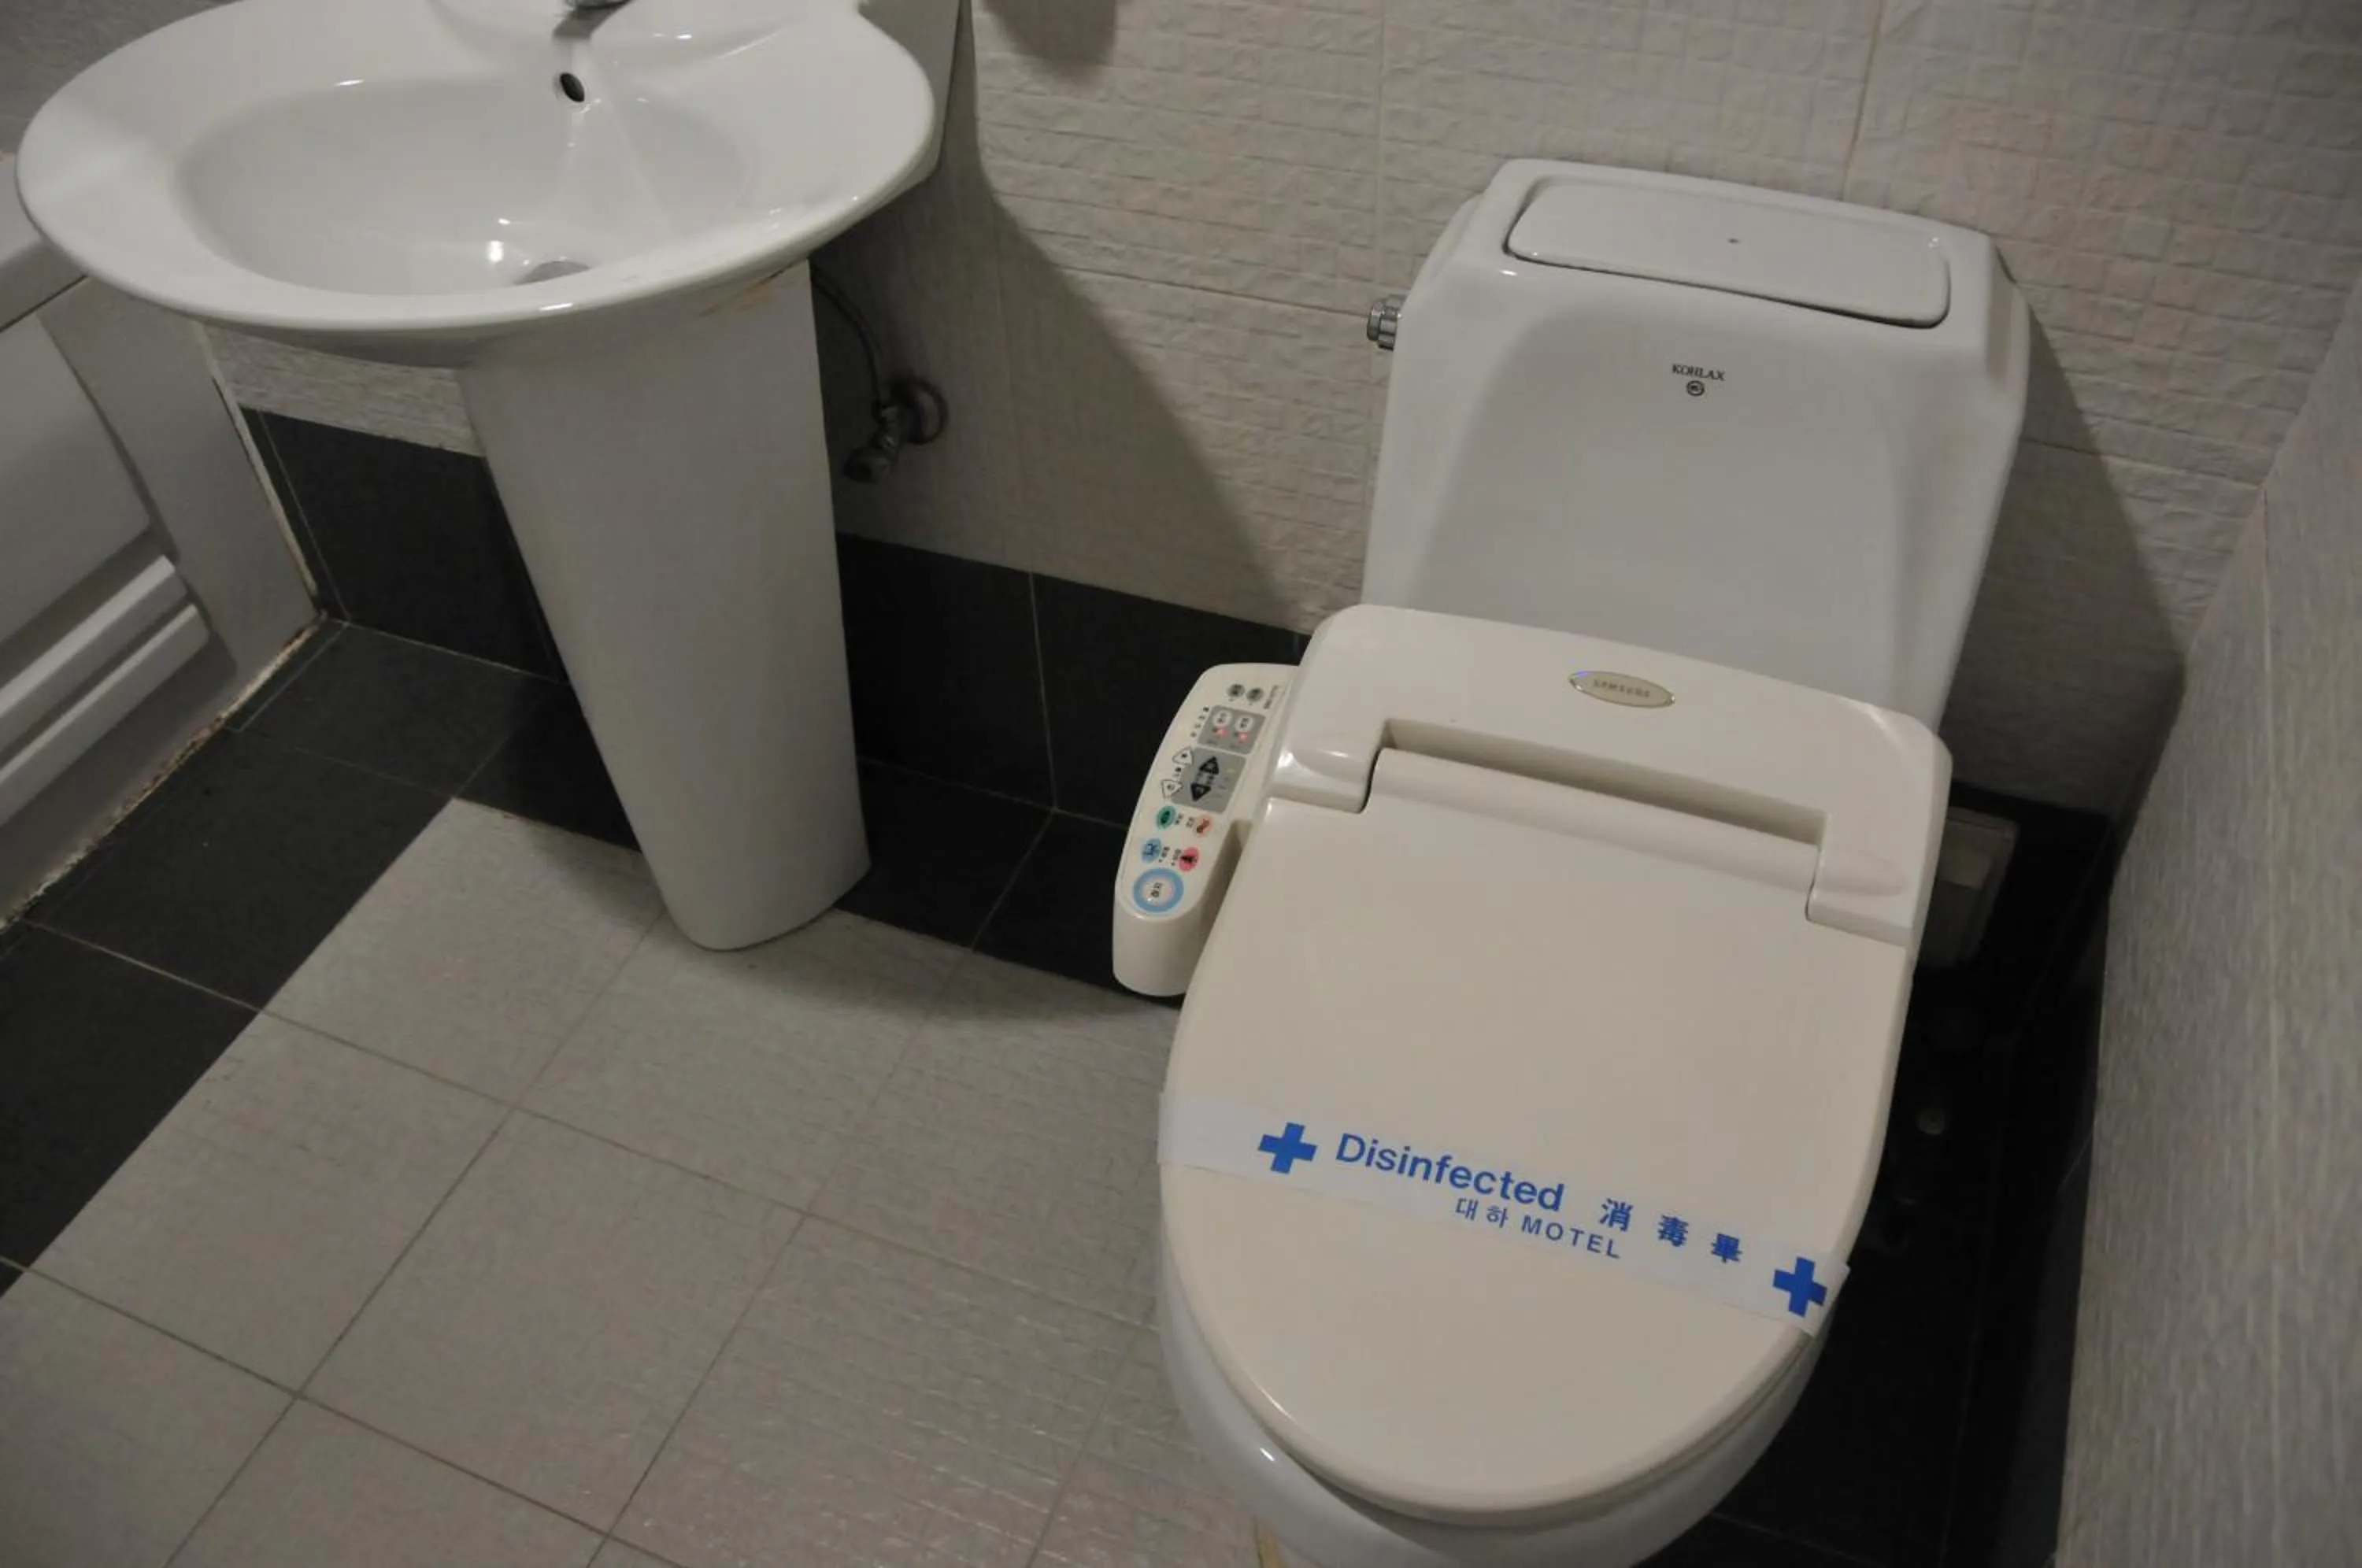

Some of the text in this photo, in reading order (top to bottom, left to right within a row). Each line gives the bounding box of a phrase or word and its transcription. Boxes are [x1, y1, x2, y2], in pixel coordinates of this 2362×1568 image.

[1593, 679, 1650, 698] SAMSUNG
[1335, 1133, 1564, 1211] Disinfected
[1521, 1215, 1620, 1259] MOTEL
